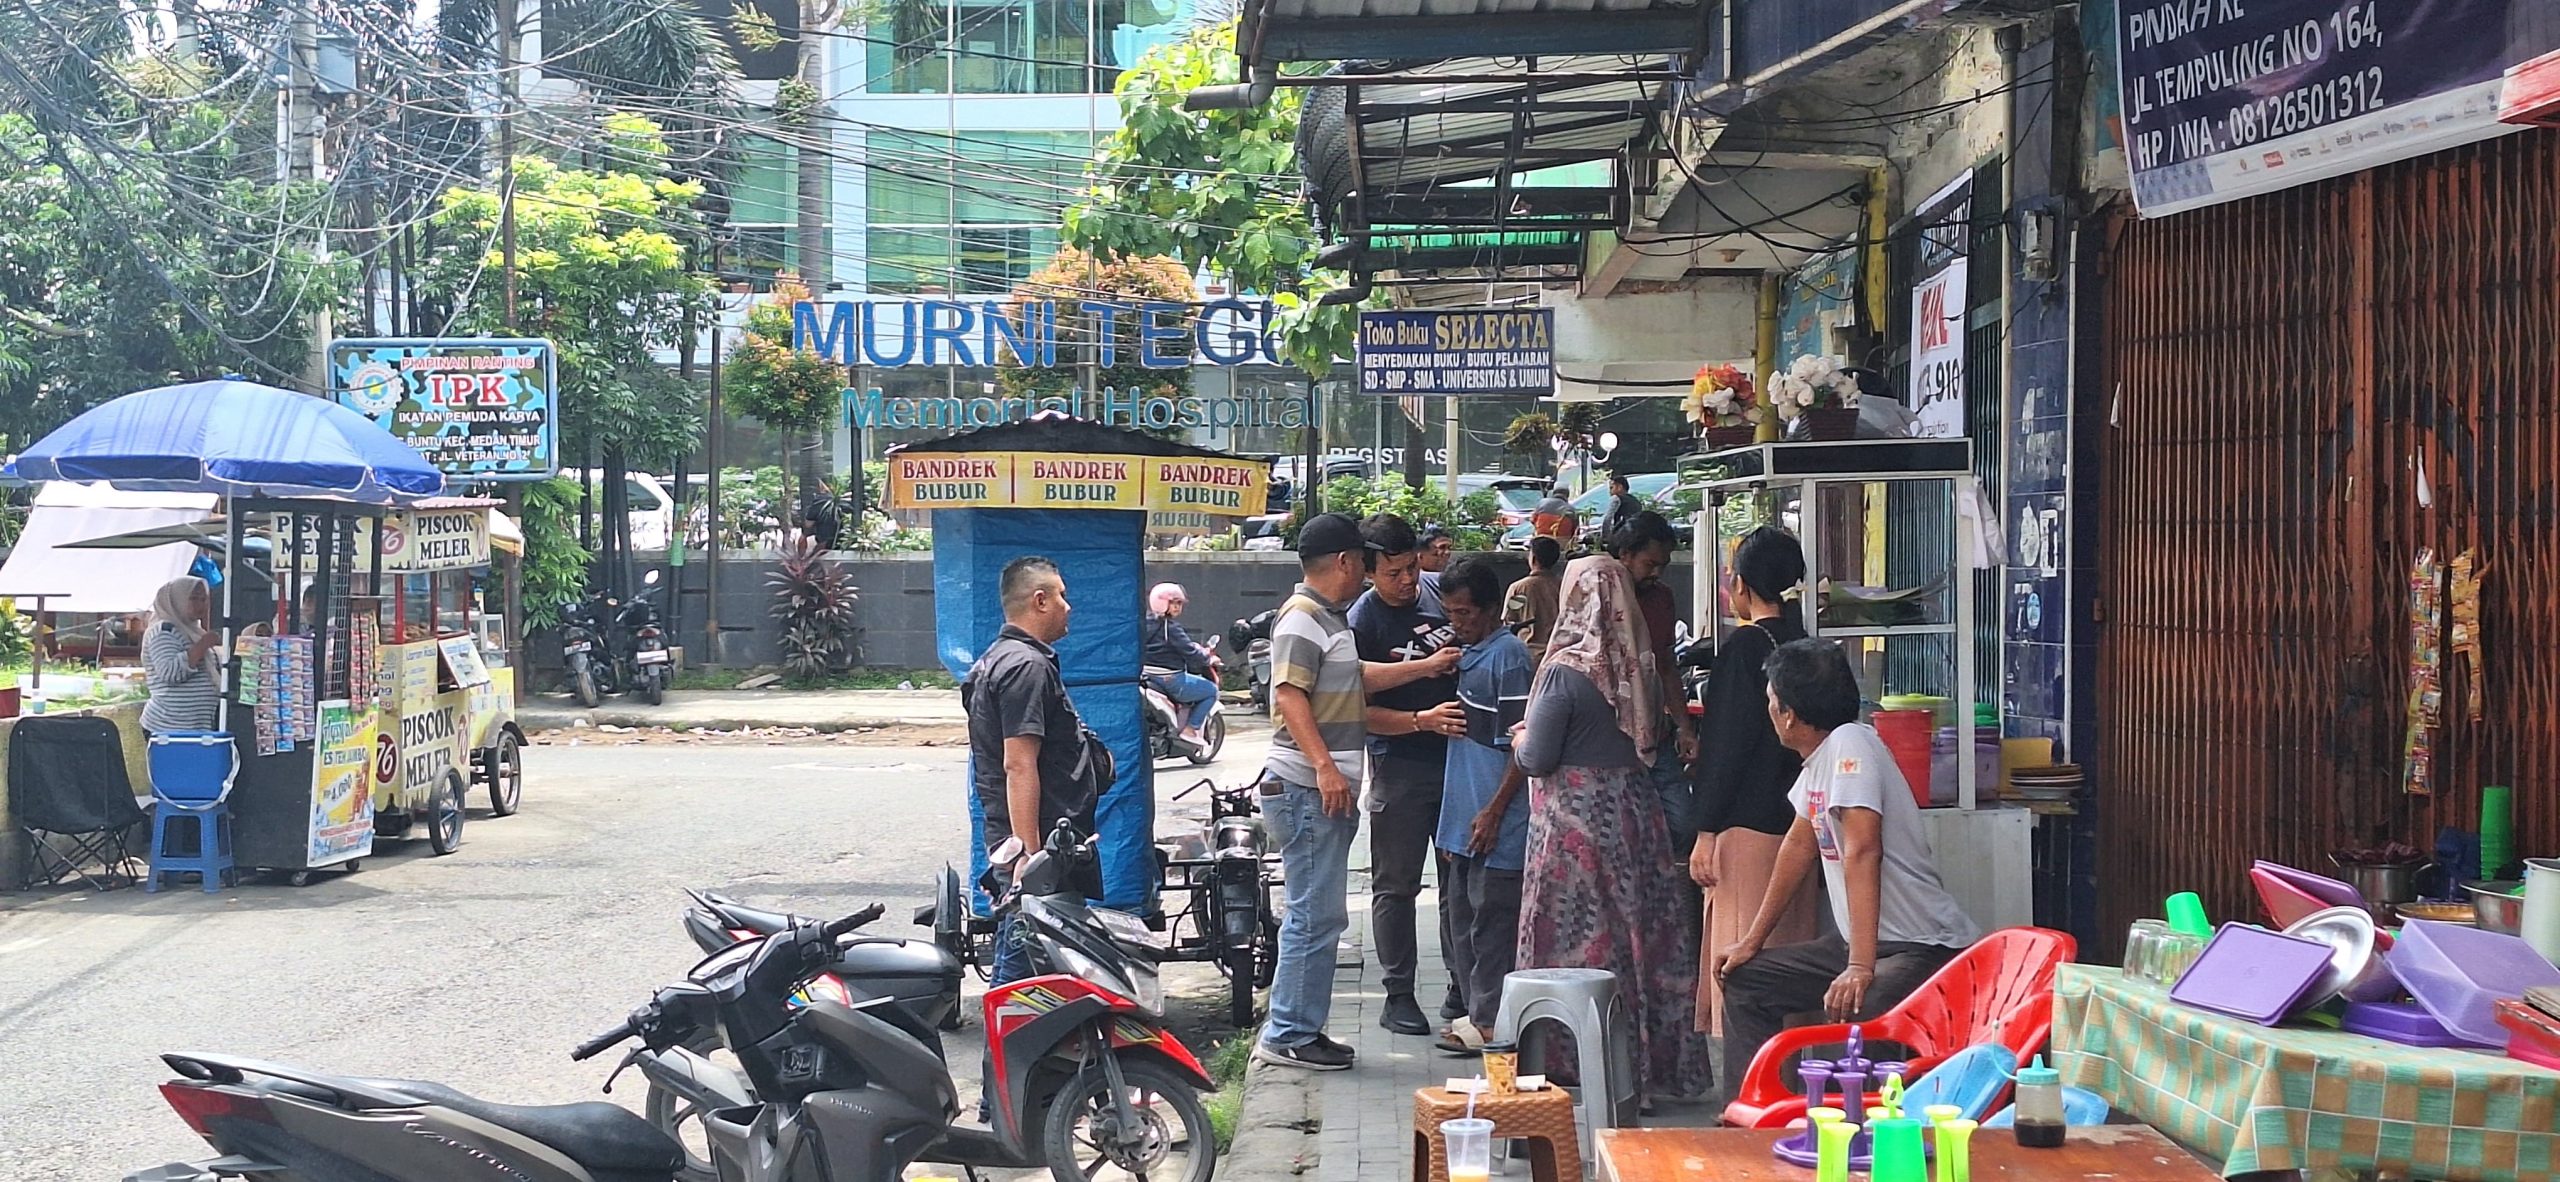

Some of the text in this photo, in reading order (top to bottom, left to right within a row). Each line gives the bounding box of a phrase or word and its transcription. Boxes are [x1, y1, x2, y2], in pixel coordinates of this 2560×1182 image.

[2129, 0, 2211, 51] PINDAH
[2131, 1, 2383, 124] JL TEMPULING NO 164,
[2137, 130, 2163, 170] HP
[2179, 116, 2216, 159] WA
[2229, 66, 2384, 146] 08126501312
[792, 298, 1300, 369] MURNI TEGU
[1364, 313, 1549, 350] Toko Buku SELECTA
[402, 356, 469, 369] PIMPINAN
[1364, 351, 1549, 368] MENYEDIAKAN BUKU BUKU PELAJARAN
[431, 376, 507, 403] IPK
[1364, 370, 1378, 390] SD
[1385, 370, 1406, 390] SMP
[1413, 370, 1435, 389] SMA
[1442, 368, 1507, 389] UNIVERSITAS
[1519, 368, 1550, 387] UMUM
[399, 411, 541, 423] IKATAN PEMUDA KARYA
[842, 384, 1321, 440] Memorial Hospital
[407, 436, 442, 447] BUNTU
[509, 434, 540, 446] TIMUR
[903, 460, 997, 478] BANDREK
[1033, 460, 1128, 481] BANDREK
[1159, 463, 1252, 487] BANDREK
[914, 483, 987, 500] BUBUR
[1044, 484, 1117, 502] BUBUR
[1170, 487, 1240, 508] BUBUR
[416, 514, 475, 536] PISCOK
[419, 538, 471, 561] MELER
[403, 706, 455, 749] PISCOK
